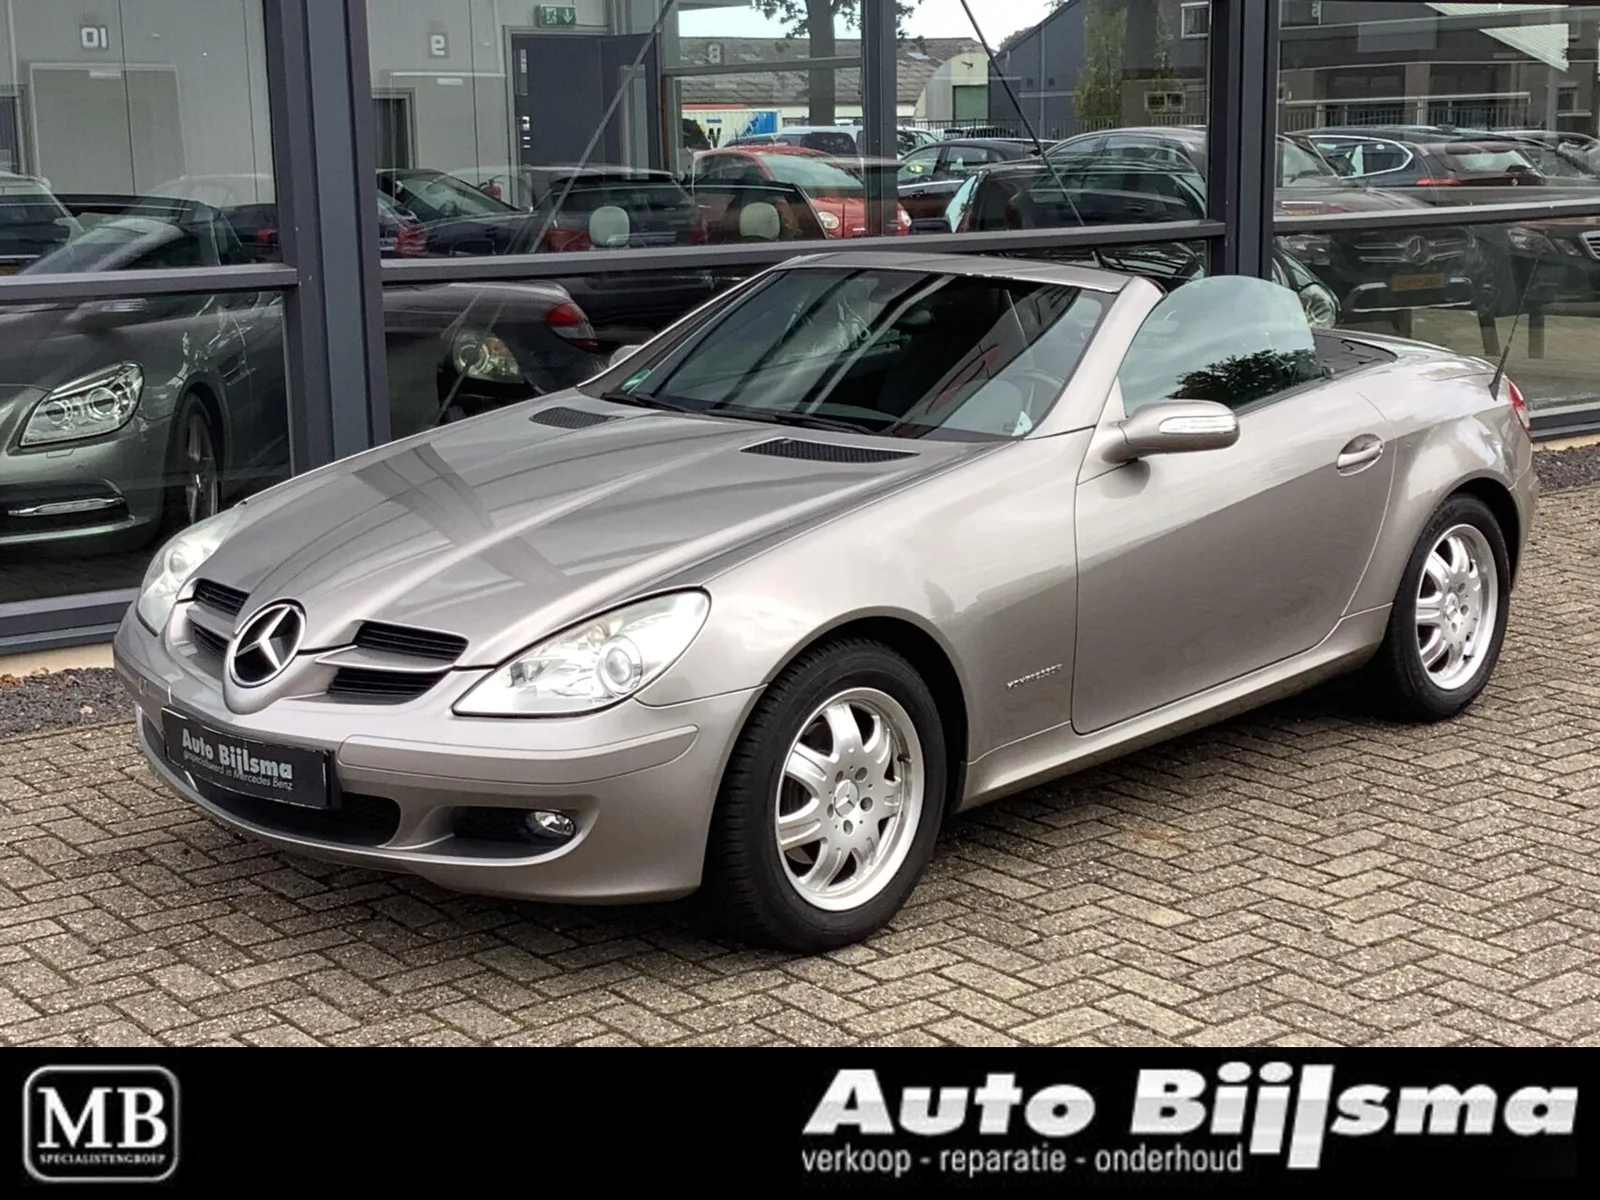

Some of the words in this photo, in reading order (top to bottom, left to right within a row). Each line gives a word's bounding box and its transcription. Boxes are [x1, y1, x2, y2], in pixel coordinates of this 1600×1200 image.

[182, 728, 214, 760] Auto
[218, 743, 293, 779] Bijlsma
[272, 776, 293, 791] Benz
